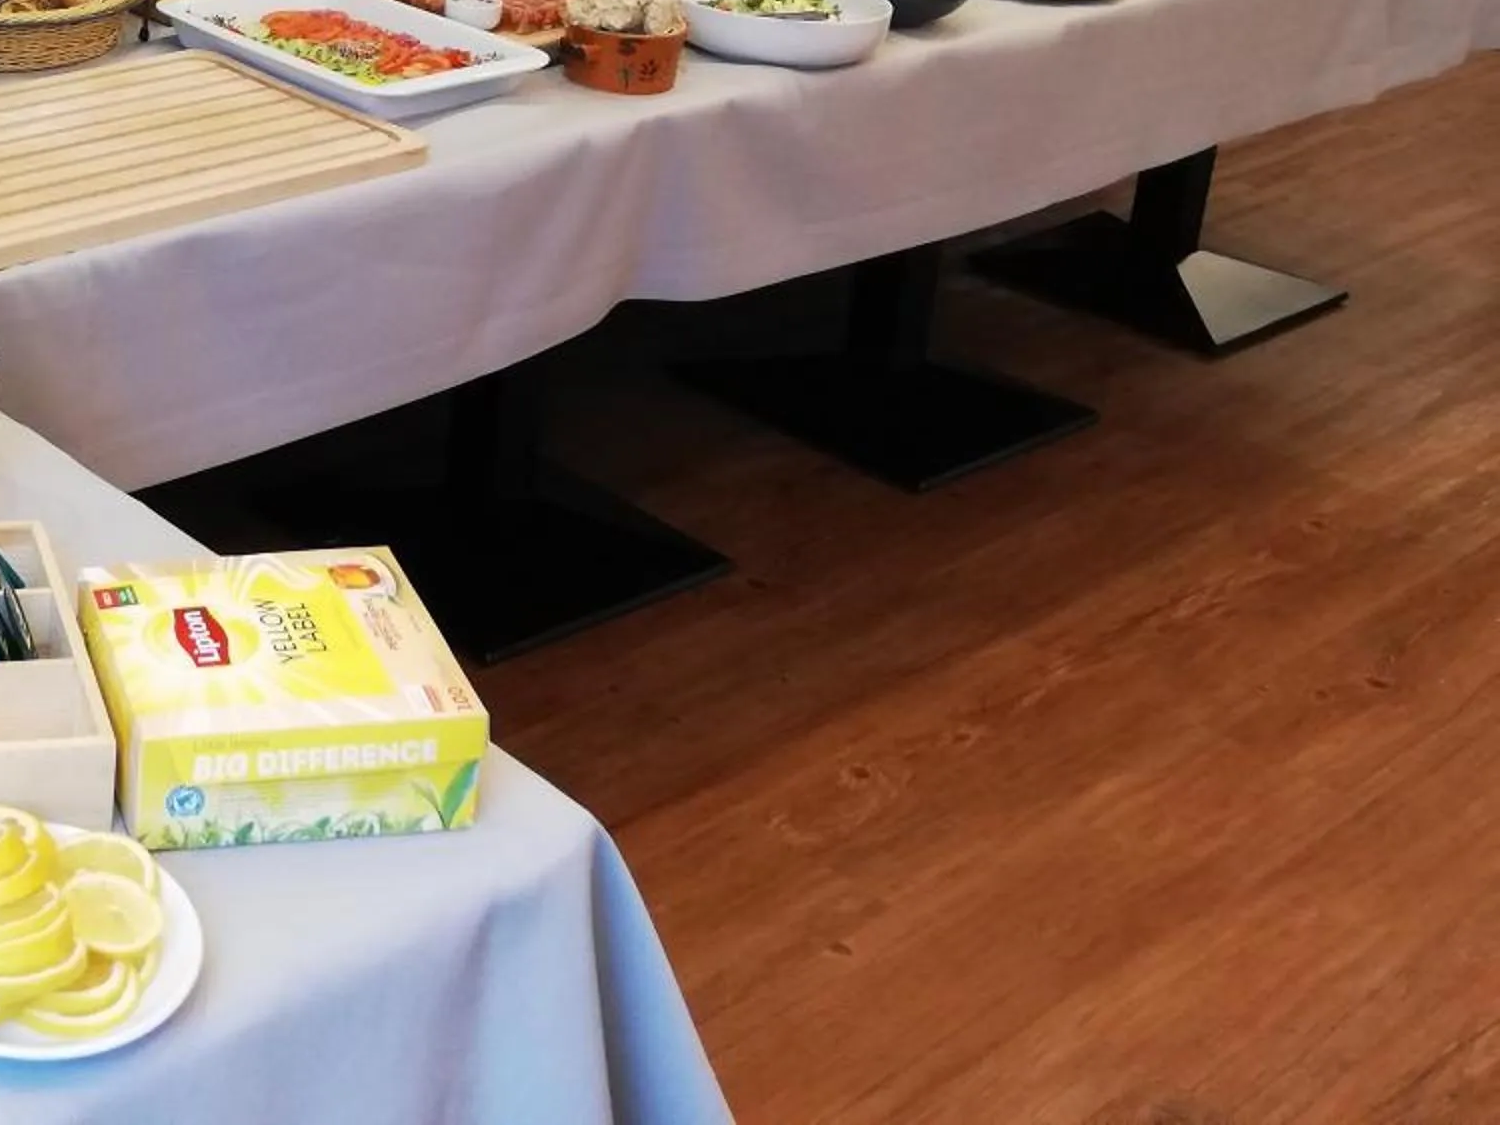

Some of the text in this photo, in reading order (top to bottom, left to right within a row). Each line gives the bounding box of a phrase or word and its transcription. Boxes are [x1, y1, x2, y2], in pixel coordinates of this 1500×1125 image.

[183, 610, 221, 664] Lipton
[253, 599, 304, 663] YELLOW
[285, 603, 327, 652] LABEL
[192, 752, 249, 781] BIG
[257, 739, 438, 778] DIFFERENCE
